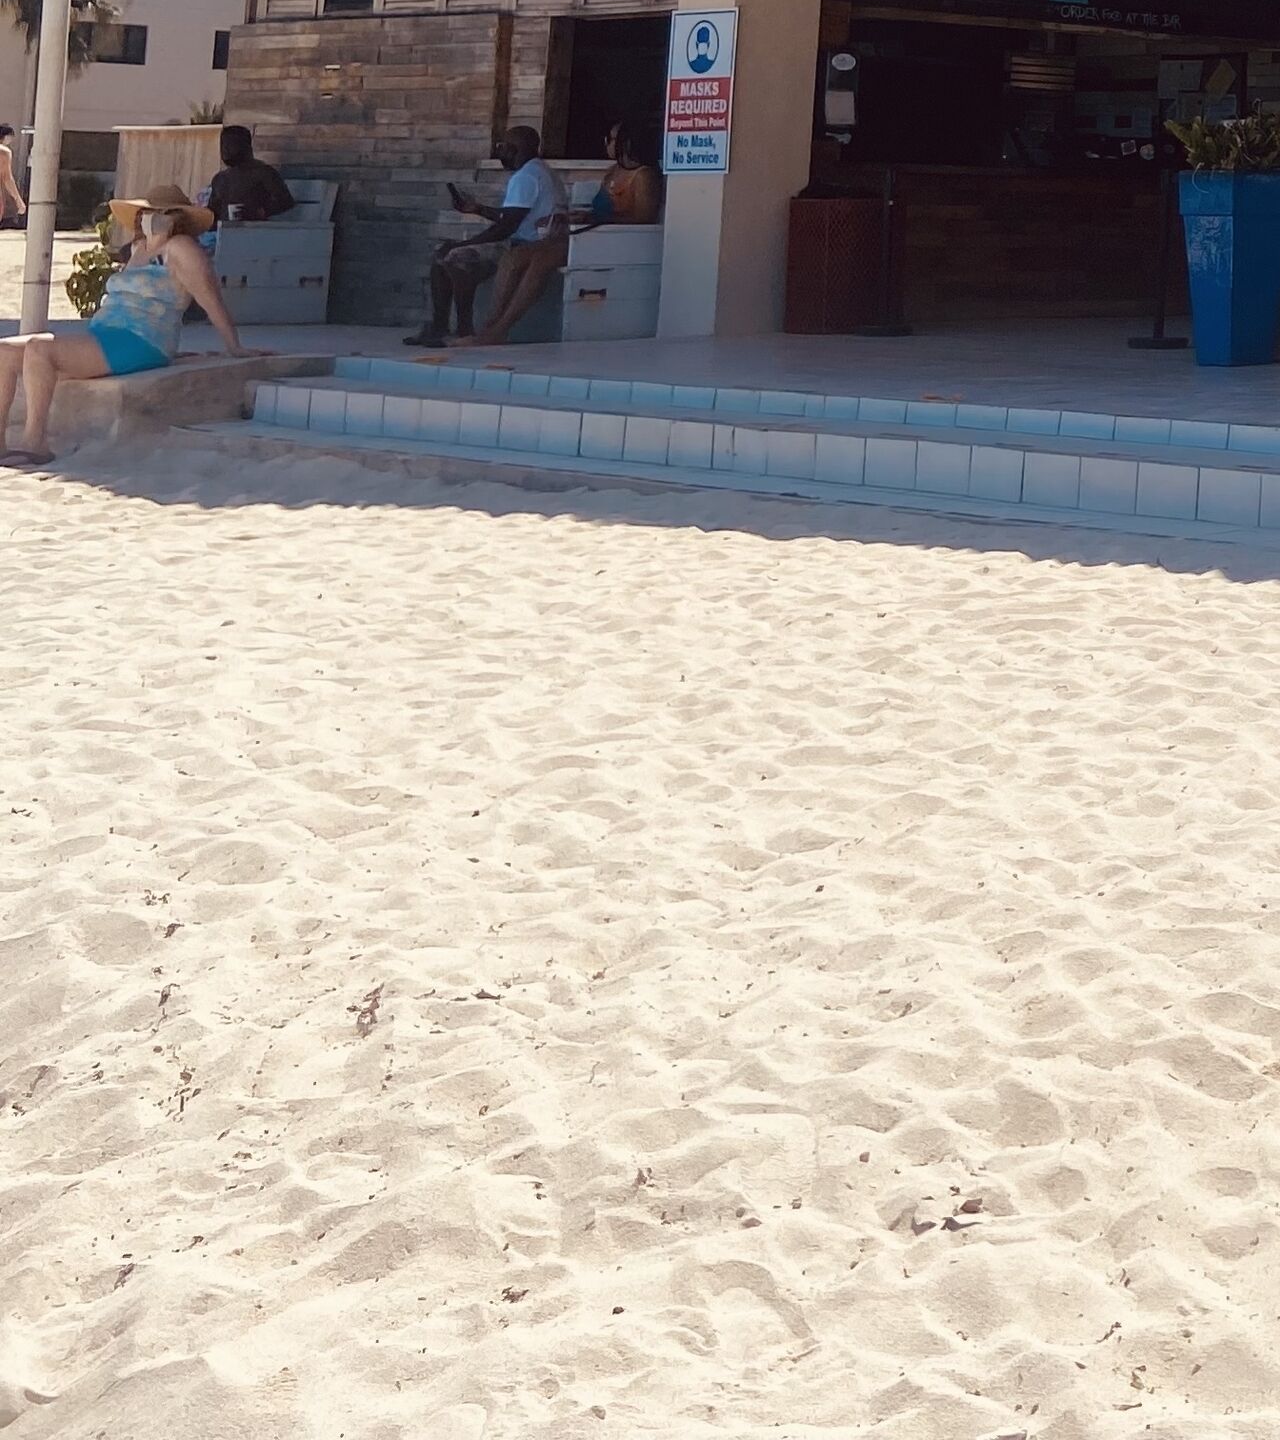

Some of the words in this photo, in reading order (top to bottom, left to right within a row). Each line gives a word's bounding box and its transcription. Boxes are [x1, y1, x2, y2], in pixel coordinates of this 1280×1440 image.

[680, 81, 720, 97] MASKS
[670, 99, 727, 115] REQUIRED
[677, 134, 689, 148] No
[691, 133, 716, 150] Mask,
[672, 151, 684, 164] No
[686, 151, 719, 164] Service
